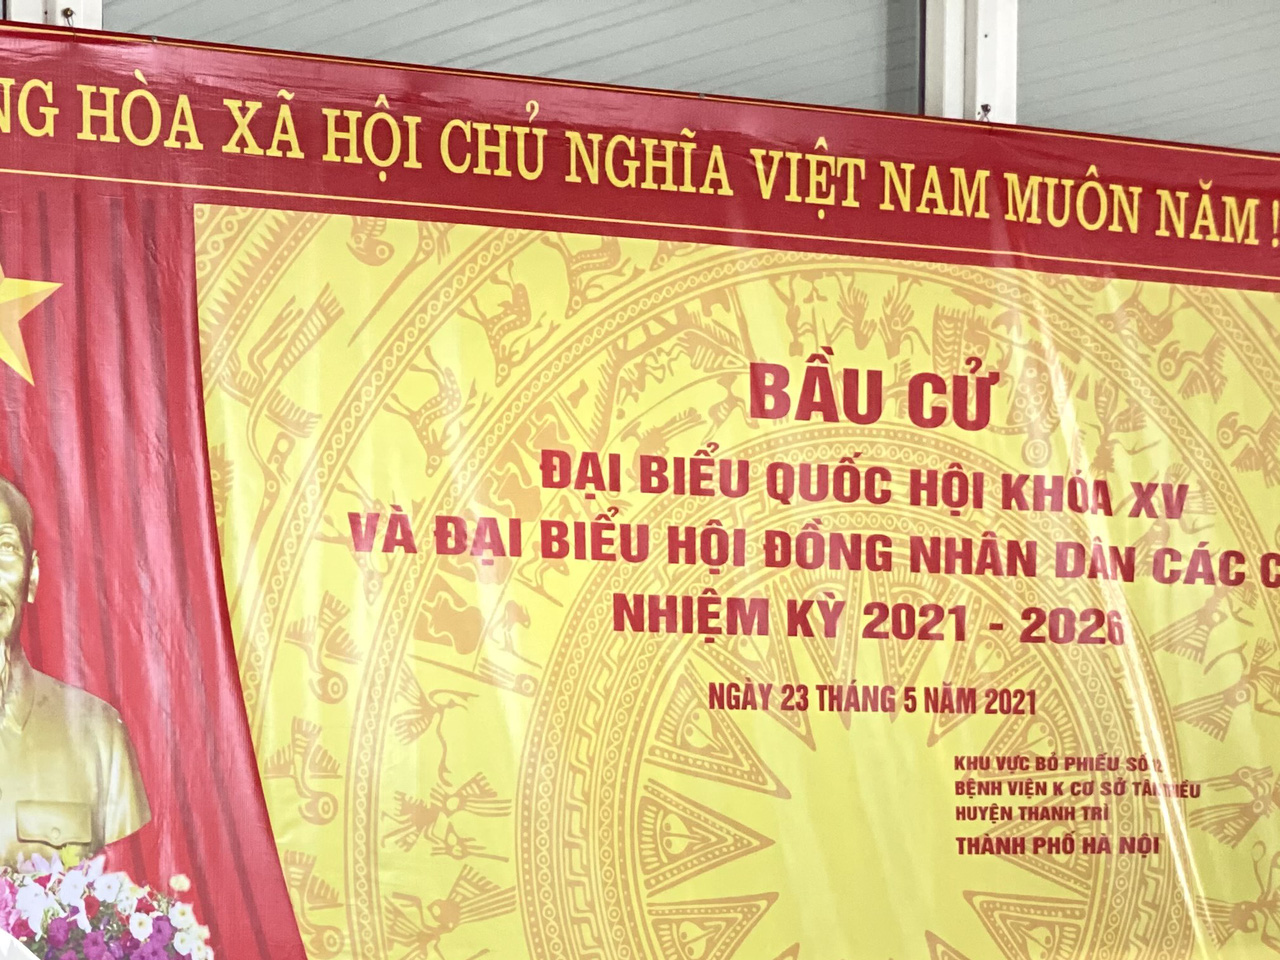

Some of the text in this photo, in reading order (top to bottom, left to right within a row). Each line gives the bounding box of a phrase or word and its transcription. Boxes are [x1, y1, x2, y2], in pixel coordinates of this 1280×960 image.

[76, 70, 204, 150] HÒA
[222, 89, 305, 159] XÃ
[322, 94, 422, 182] HỘI
[440, 101, 548, 180] CHỦ
[565, 127, 734, 196] NGHĨA
[749, 137, 866, 219] VIỆT
[879, 160, 990, 219] NAM
[1003, 164, 1143, 234] MUÔN
[1155, 178, 1260, 245] NĂM
[749, 346, 1001, 431] BẦU CỬ
[539, 449, 621, 500] ĐẠI
[639, 442, 750, 498] BIỂU
[766, 452, 892, 505] QUỐC
[909, 462, 984, 517] HỘI
[1130, 482, 1189, 519] XV
[348, 505, 417, 554] VÀ
[433, 515, 522, 566] ĐẠI
[540, 506, 649, 563] BIỂU
[667, 519, 746, 575] HỘI
[763, 518, 893, 572] ĐỒNG
[909, 531, 1037, 578] NHÂN
[1056, 536, 1136, 582] DÂN
[1152, 541, 1246, 586] CÁC
[613, 587, 1124, 645] NHIỆM KỲ 2021 - 2026
[708, 677, 1036, 715] NGÀY 23 THÁNG 5 NĂM 2021
[954, 755, 990, 771] KHU
[996, 755, 1030, 774] VỰC
[1035, 752, 1059, 771] BỎ
[1064, 752, 1120, 771] PHIẾU
[1126, 752, 1149, 771] SỐ
[955, 778, 1002, 799] BỆNH
[1008, 778, 1047, 799] VIỆN
[1053, 782, 1064, 795] K
[1070, 780, 1095, 796] CƠ
[1100, 777, 1127, 796] SỞ
[955, 803, 1109, 824] HUYỆN THANH TRÌ
[956, 831, 1160, 858] THÀNH PHỐ HÀ NỘI
